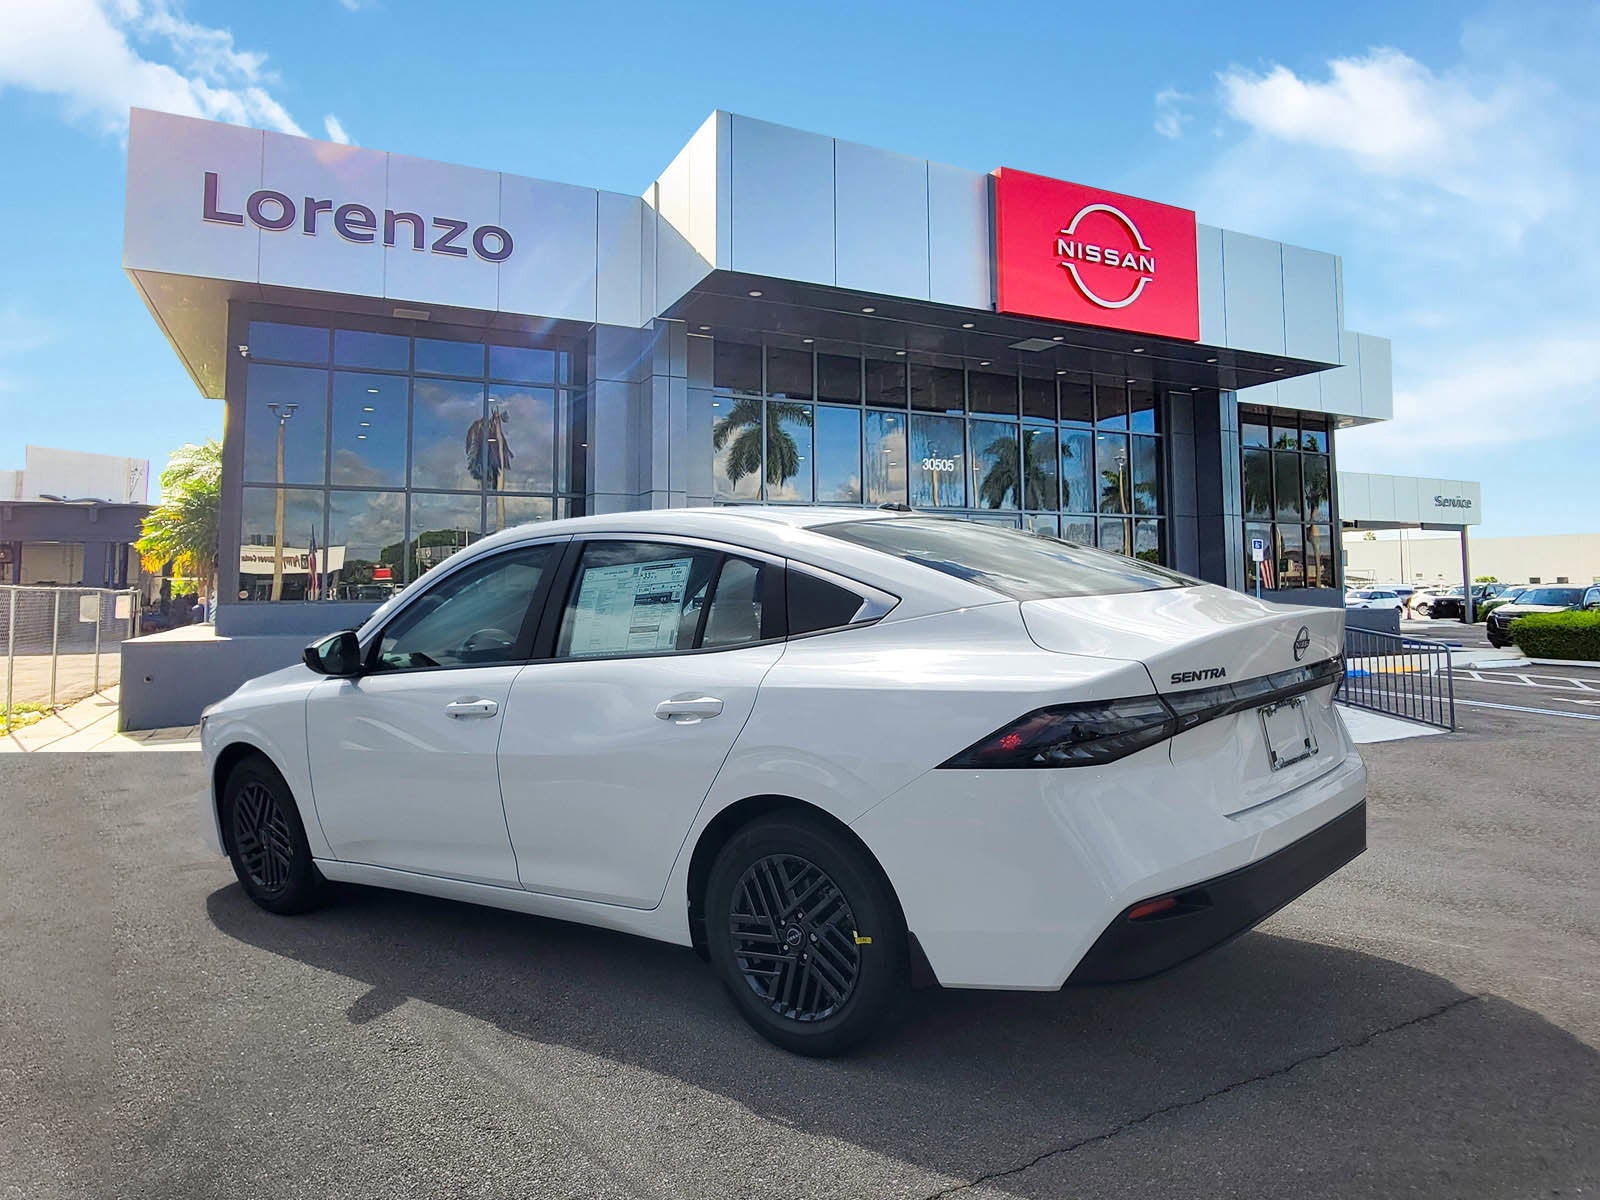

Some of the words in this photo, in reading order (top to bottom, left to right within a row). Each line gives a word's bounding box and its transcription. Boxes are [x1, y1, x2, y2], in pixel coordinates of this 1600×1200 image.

[203, 171, 514, 262] Lorenzo
[1057, 238, 1155, 273] NISSAN
[922, 458, 955, 472] 30505
[1433, 495, 1472, 508] Service
[1170, 667, 1227, 684] SENTRA
